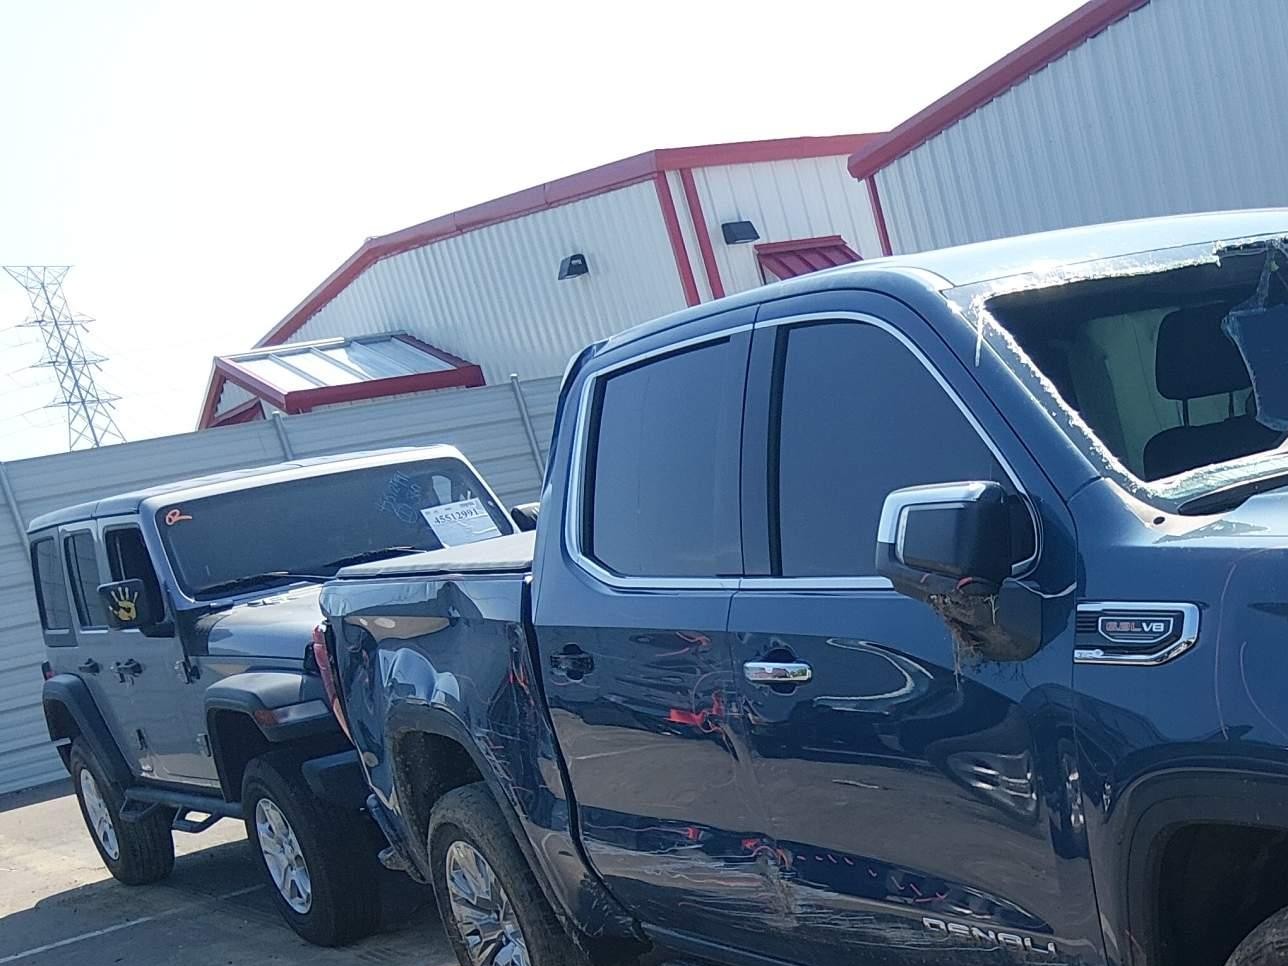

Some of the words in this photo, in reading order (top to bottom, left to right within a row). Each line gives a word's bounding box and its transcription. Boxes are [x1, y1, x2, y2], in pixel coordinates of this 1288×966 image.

[434, 508, 479, 525] 45512991
[1142, 622, 1165, 632] V8
[922, 917, 1056, 956] DENALI
